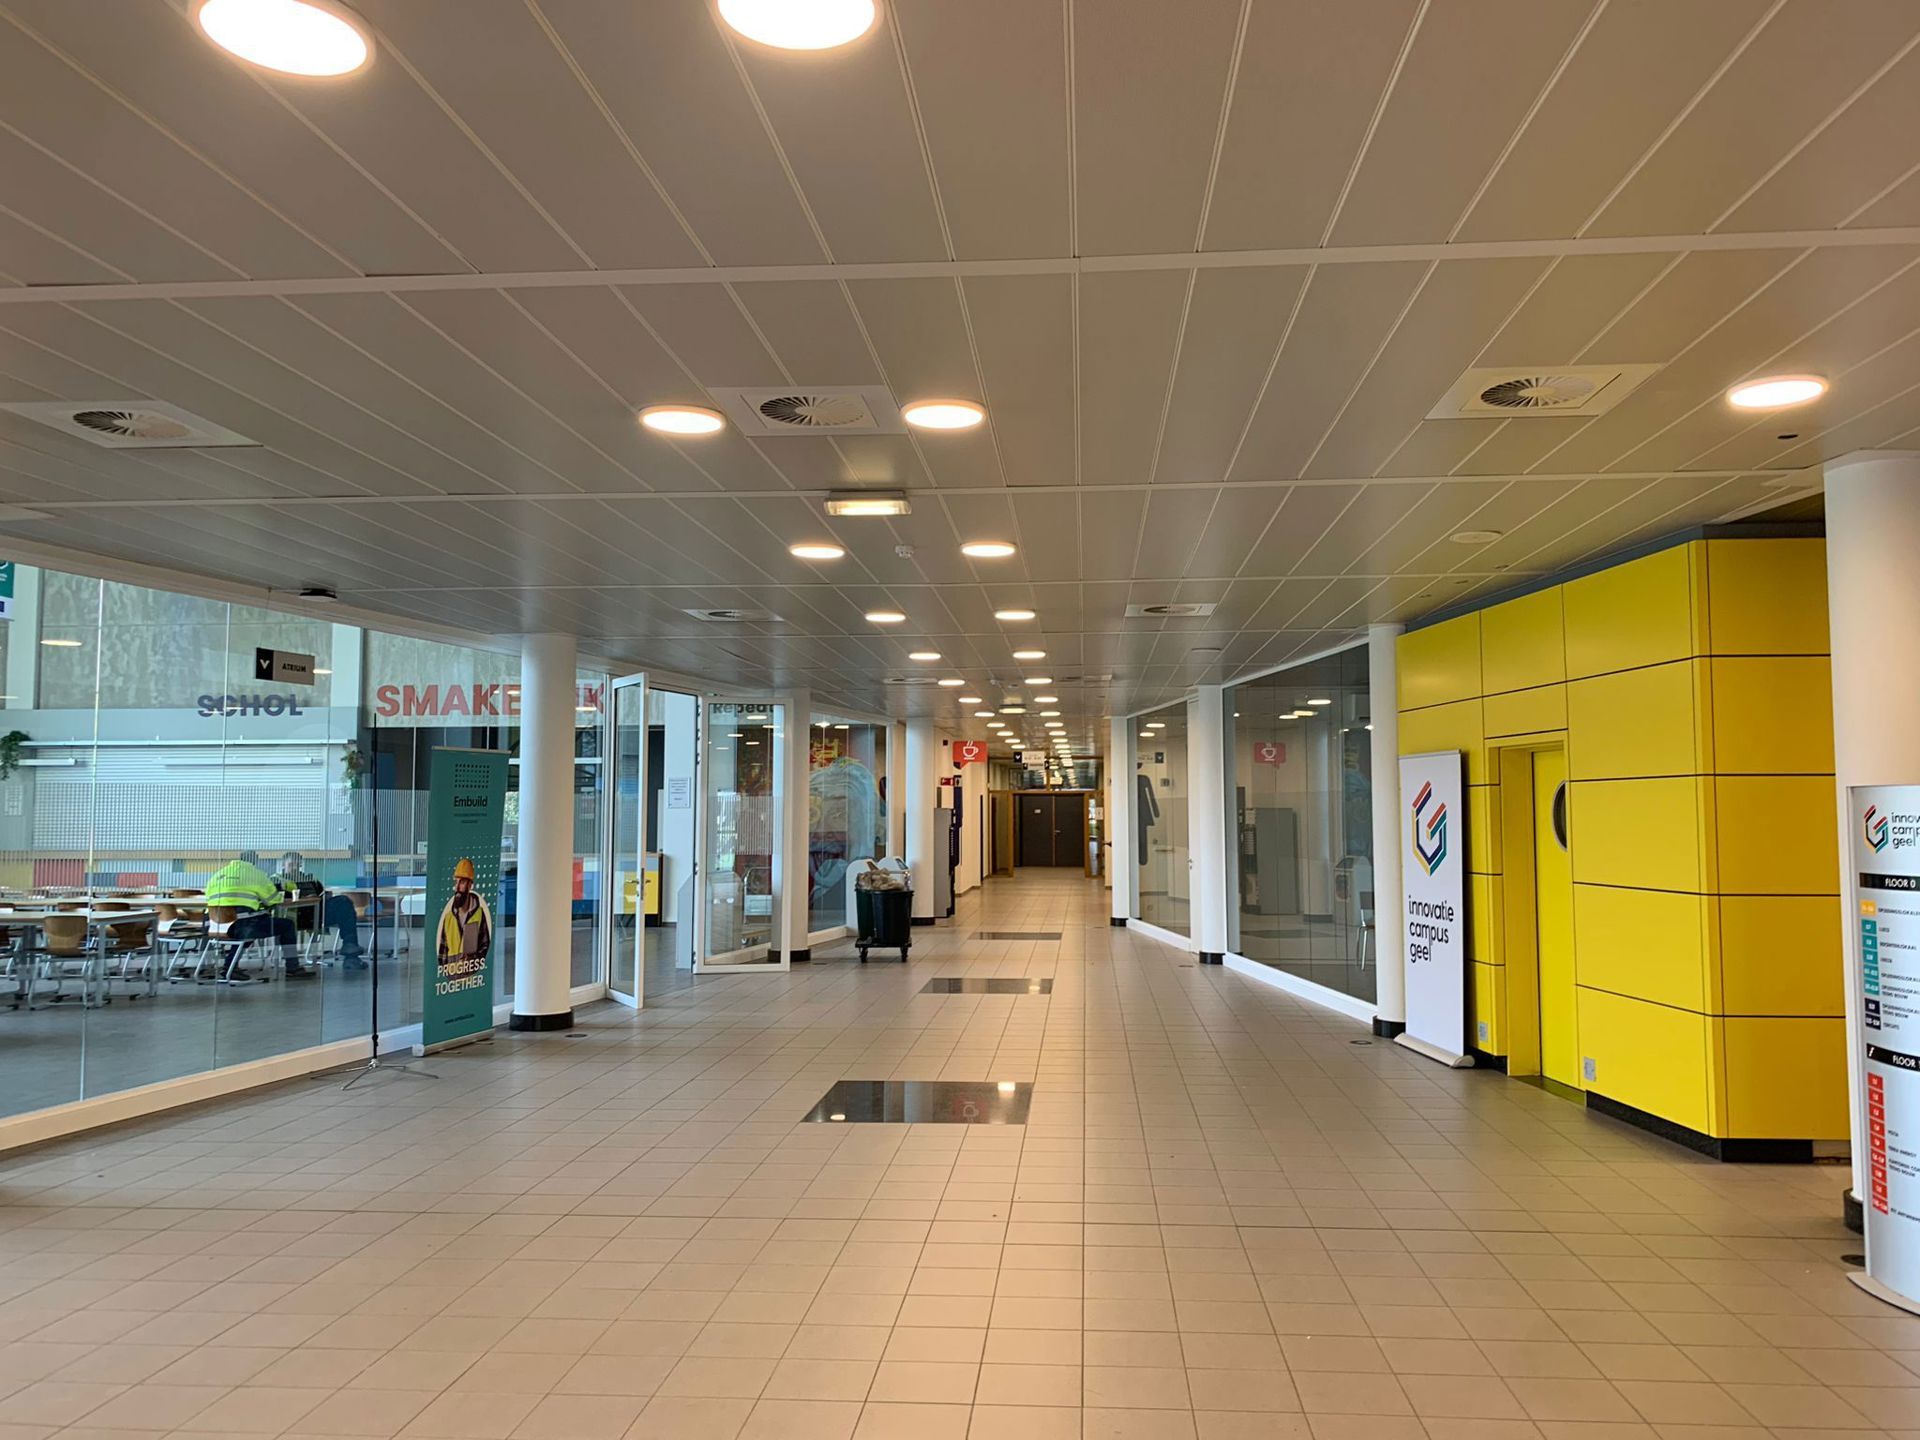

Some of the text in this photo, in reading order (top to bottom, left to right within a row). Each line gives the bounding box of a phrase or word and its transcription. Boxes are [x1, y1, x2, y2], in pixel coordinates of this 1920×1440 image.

[282, 662, 306, 673] ATRIUM
[197, 694, 303, 717] SCHOL
[454, 796, 488, 807] Embuild
[1893, 837, 1916, 849] geel
[1885, 878, 1909, 888] FLOOR
[1408, 894, 1454, 922] innovatie
[1409, 922, 1449, 944] campus
[1410, 942, 1432, 963] geel
[437, 957, 488, 978] PROGRESS.
[435, 974, 486, 996] TOGETHER.
[1892, 1054, 1916, 1068] FLOOR
